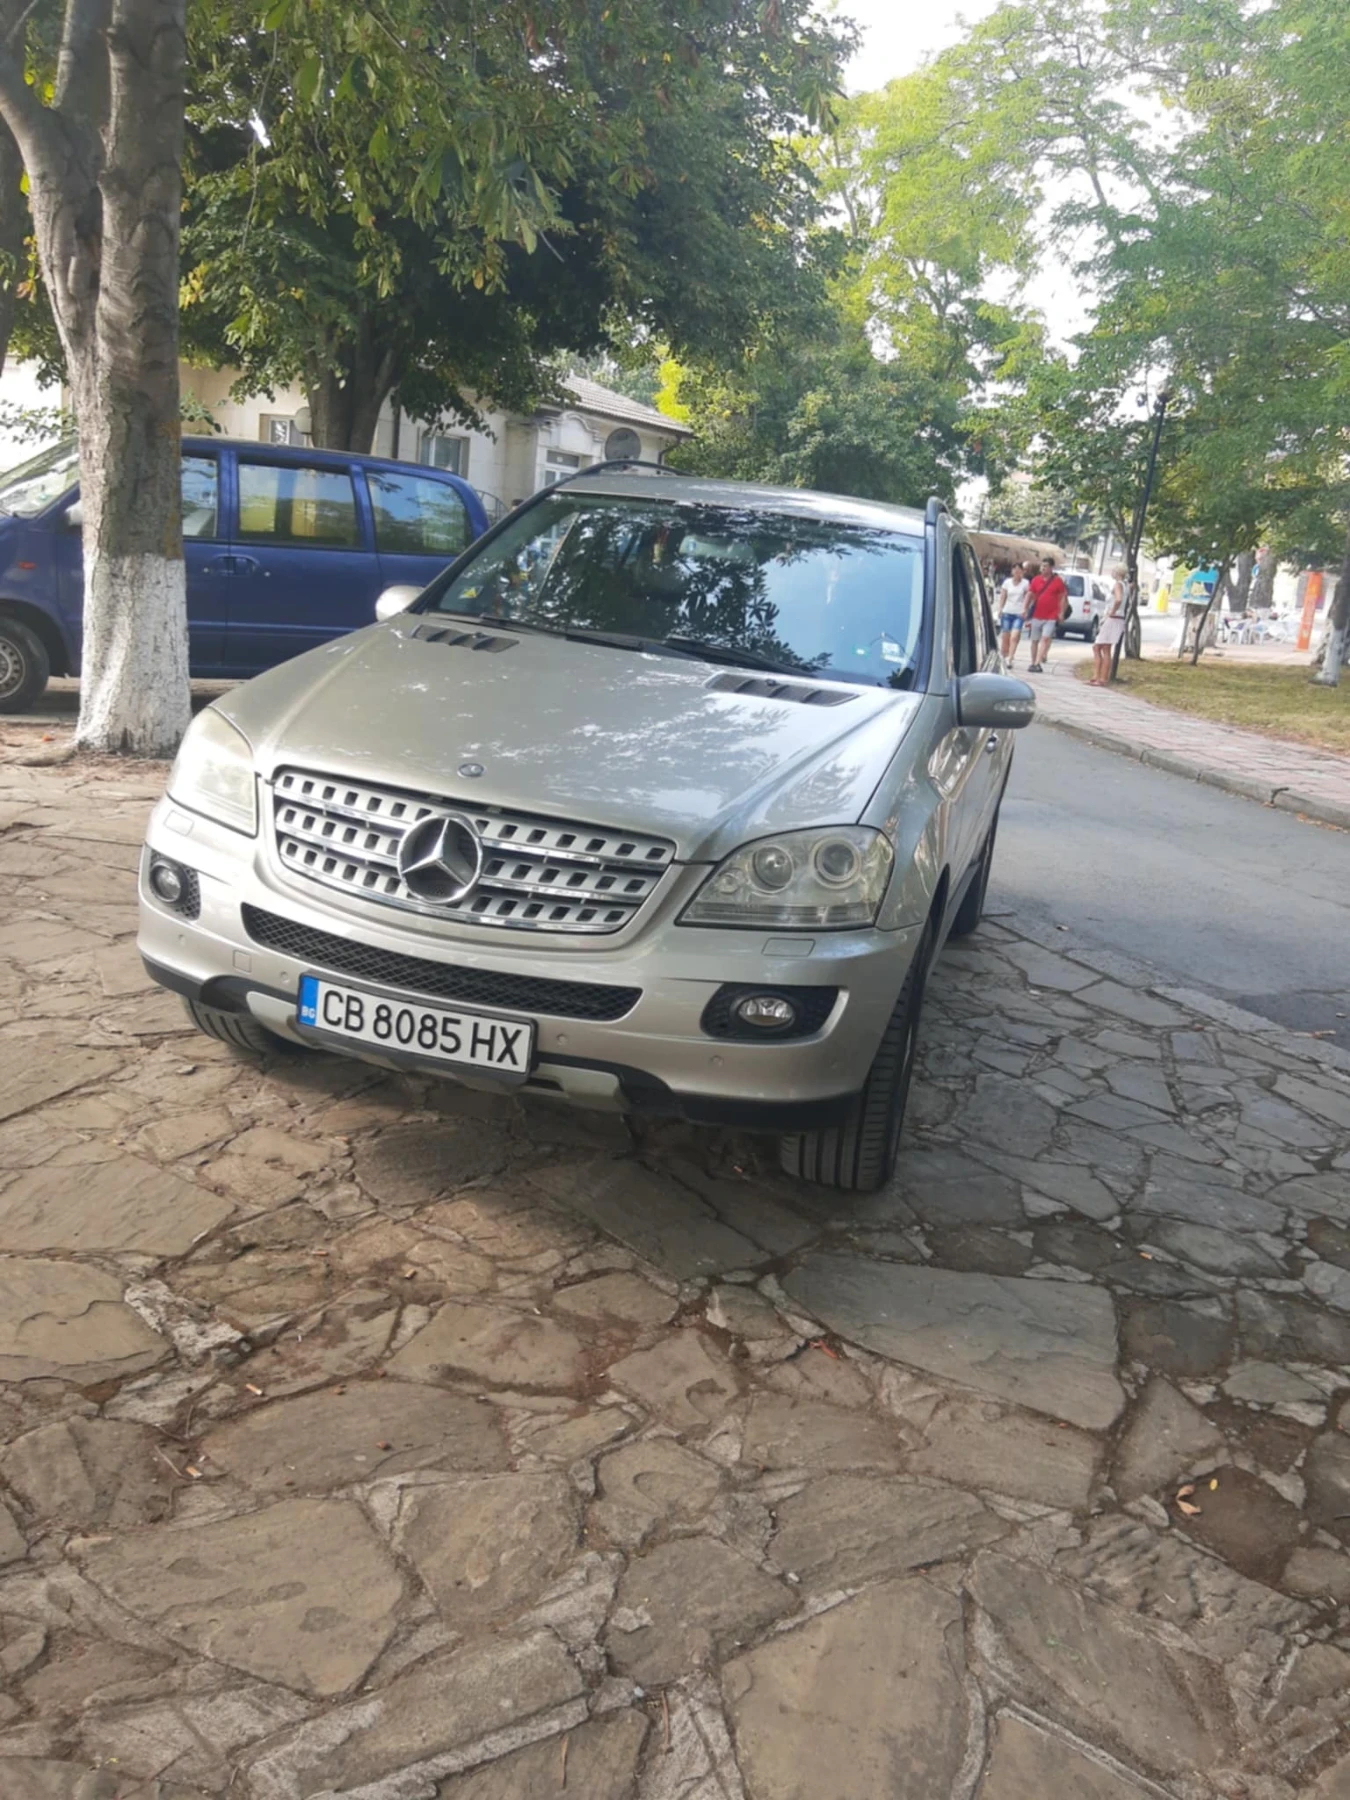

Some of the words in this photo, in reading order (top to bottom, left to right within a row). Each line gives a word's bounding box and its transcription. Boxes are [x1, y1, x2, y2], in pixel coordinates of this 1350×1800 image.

[301, 1005, 316, 1019] BG
[322, 990, 365, 1032] CB
[373, 1004, 462, 1054] 8085
[469, 1022, 522, 1066] HX
